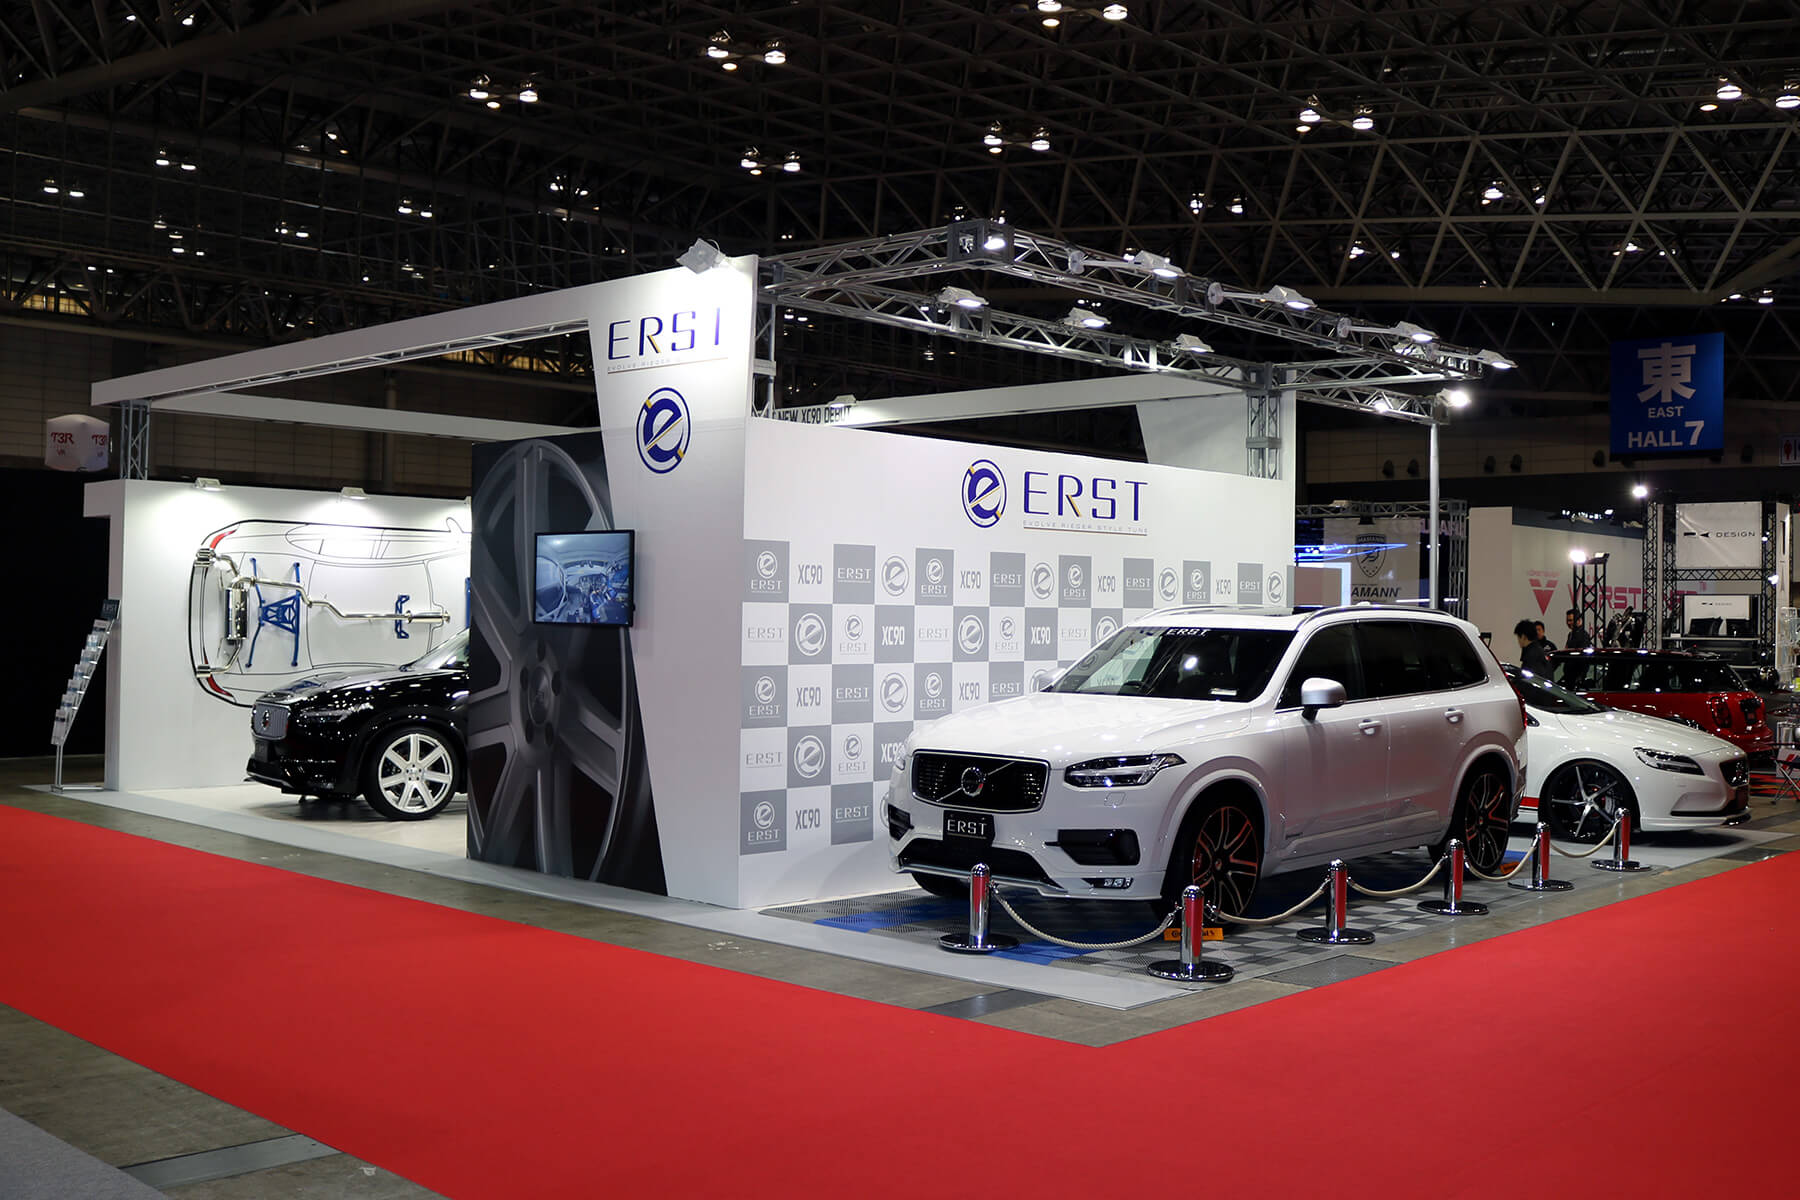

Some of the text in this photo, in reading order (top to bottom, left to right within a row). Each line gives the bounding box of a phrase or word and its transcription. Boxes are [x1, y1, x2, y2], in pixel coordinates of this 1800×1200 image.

[1637, 342, 1697, 403] 東
[801, 408, 822, 424] XC90
[1648, 405, 1684, 419] EAST
[1628, 420, 1705, 449] HALL 7
[1024, 471, 1149, 521] ERST
[1715, 530, 1756, 539] DESIGN
[798, 564, 823, 585] XC90
[837, 568, 872, 580] ERST
[960, 570, 982, 589] XC90
[993, 573, 1023, 585] ERST
[751, 580, 783, 590] ERST
[1097, 575, 1116, 593] XC90
[1126, 577, 1151, 589] ERST
[1215, 579, 1232, 595] XC90
[1240, 581, 1261, 591] ERST
[921, 585, 948, 595] ERST
[1063, 589, 1087, 598] ERST
[1186, 591, 1208, 600] ERST
[1351, 587, 1399, 598] AMANN
[747, 627, 785, 639] ERST
[882, 626, 905, 646] XC90
[918, 628, 949, 639] ERST
[1031, 626, 1051, 645] XC90
[1165, 628, 1211, 637] ERST
[839, 642, 868, 652] ERST
[836, 688, 869, 700] ERST
[959, 682, 980, 701] XC90
[992, 683, 1021, 694] ERST
[796, 687, 821, 708] XC90
[749, 704, 781, 716] ERST
[919, 699, 945, 709] ERST
[745, 752, 784, 766] ERST
[838, 761, 867, 773] ERST
[795, 808, 821, 830] XC90
[835, 806, 869, 820] ERST
[947, 819, 988, 835] ERST
[747, 829, 780, 842] ERST
